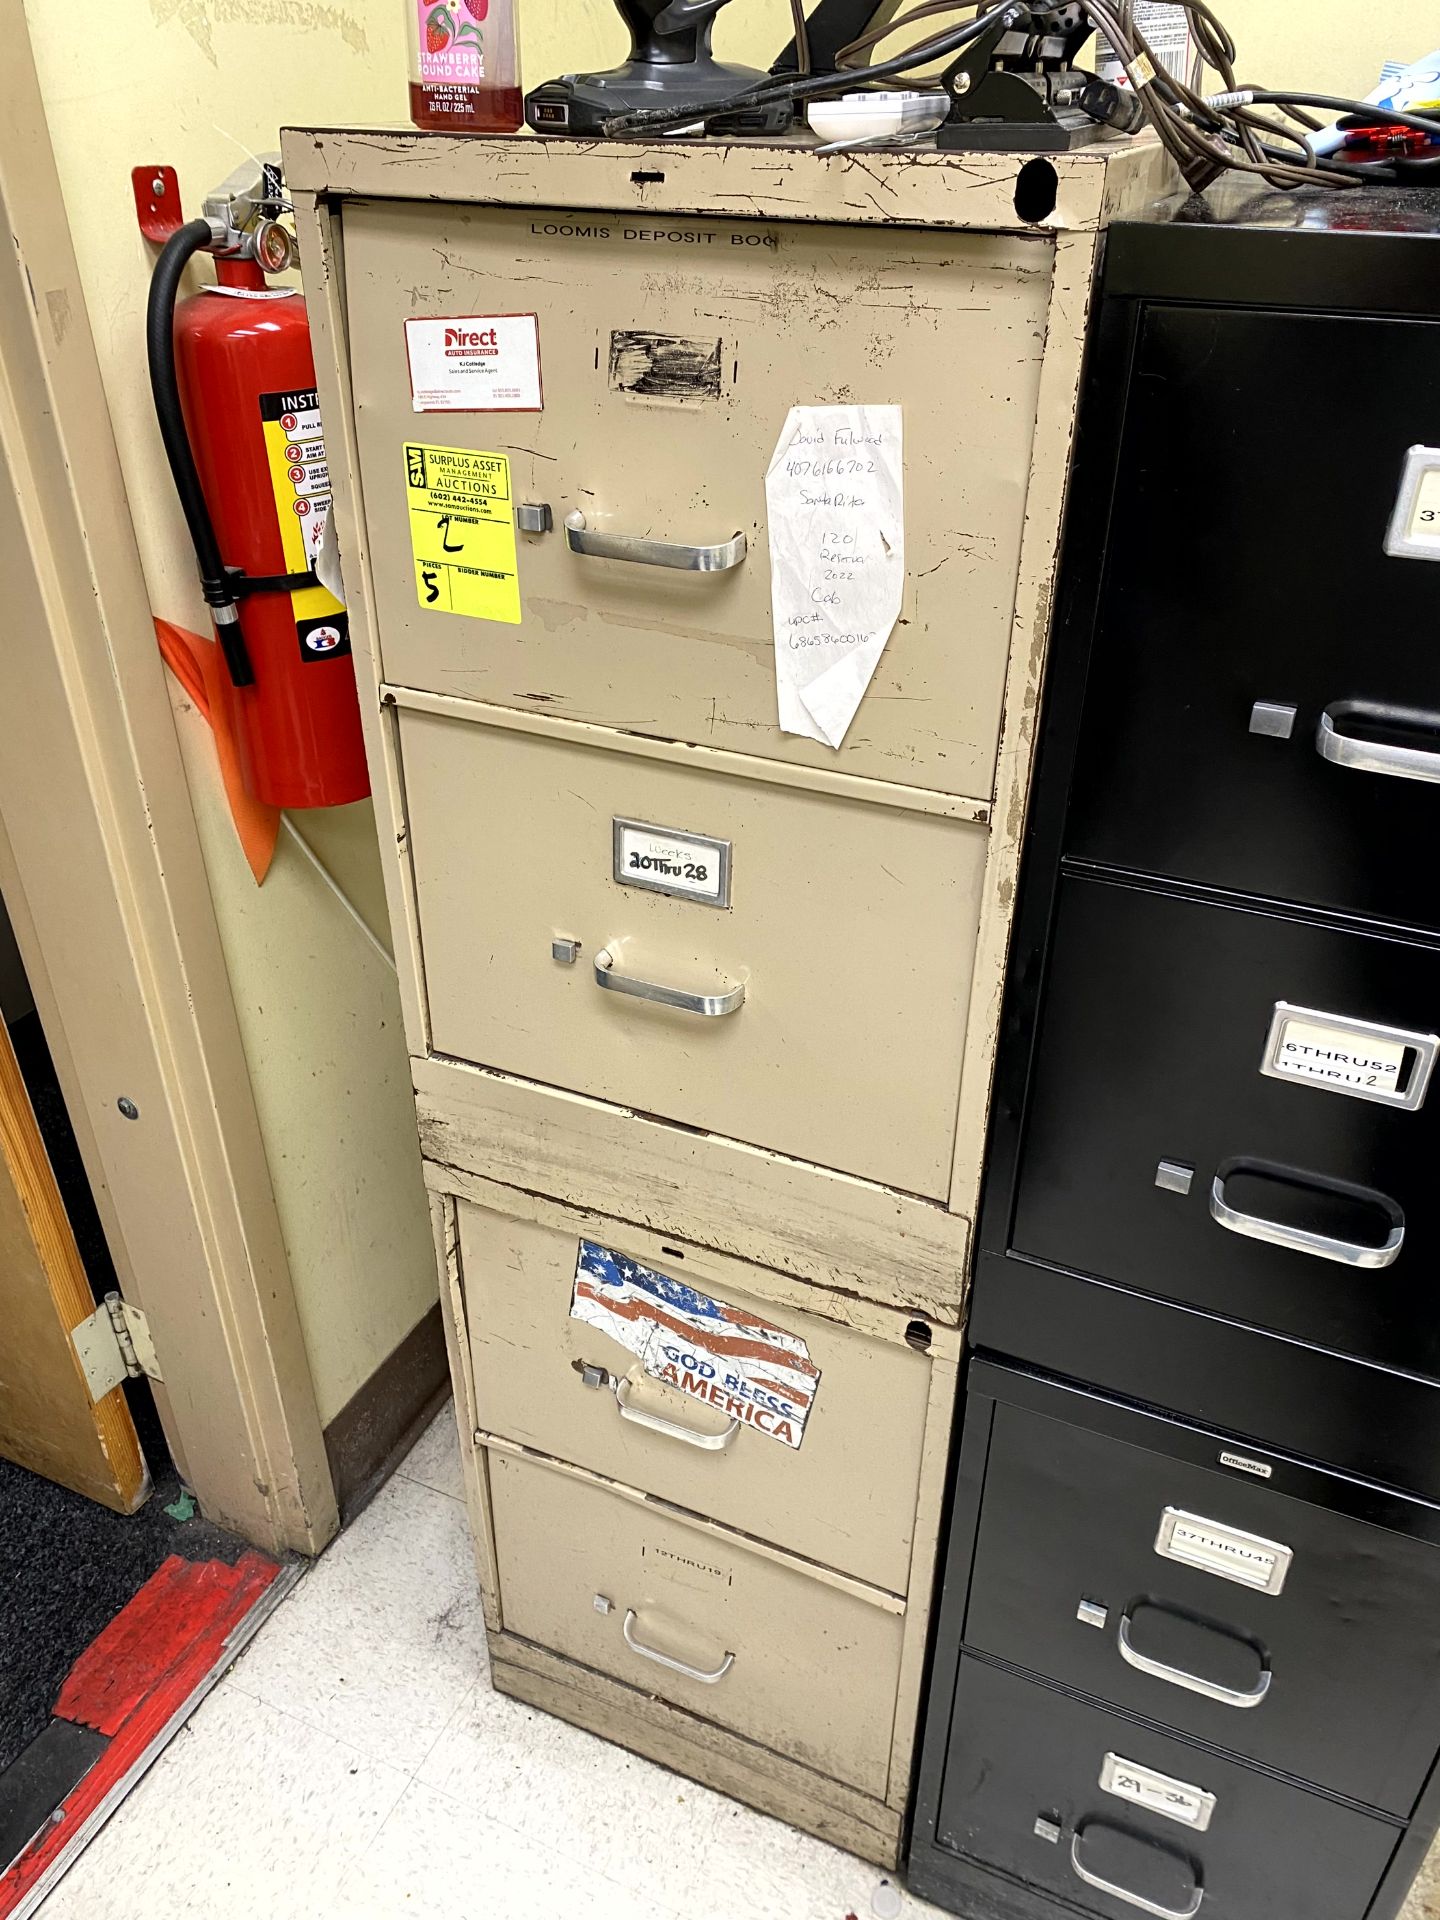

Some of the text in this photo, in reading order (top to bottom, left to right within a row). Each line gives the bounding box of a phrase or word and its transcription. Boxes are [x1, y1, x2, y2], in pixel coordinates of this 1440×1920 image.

[417, 52, 485, 66] STRAWBERRY
[417, 65, 485, 78] POUND CAKE
[422, 85, 480, 94] ANTI-BACTERIAL
[453, 103, 465, 113] 225
[531, 223, 611, 239] LOOMIS
[623, 229, 717, 244] DEPOSIT
[445, 328, 497, 346] Direct
[290, 449, 298, 458] 2
[305, 444, 323, 453] START
[429, 454, 502, 473] SURPLUS ASSET
[293, 469, 301, 479] 3
[439, 466, 493, 480] MANAGEMENT
[436, 477, 497, 495] AUCTIONS
[430, 491, 488, 506] (602) 442-4554
[298, 502, 306, 512] 4
[314, 505, 327, 513] SIDE
[427, 500, 493, 515] www.samauctions.com
[441, 514, 479, 525] LOT NUMBER
[422, 561, 506, 581] PIECES BIDDER NUMBER
[824, 569, 855, 581] 2022
[421, 571, 440, 603] 5
[811, 587, 841, 605] Cab
[684, 863, 708, 882] 28
[661, 1345, 795, 1419] GOD BLESS
[661, 1362, 794, 1444] AMERICA
[1222, 1455, 1269, 1475] OfficeMax
